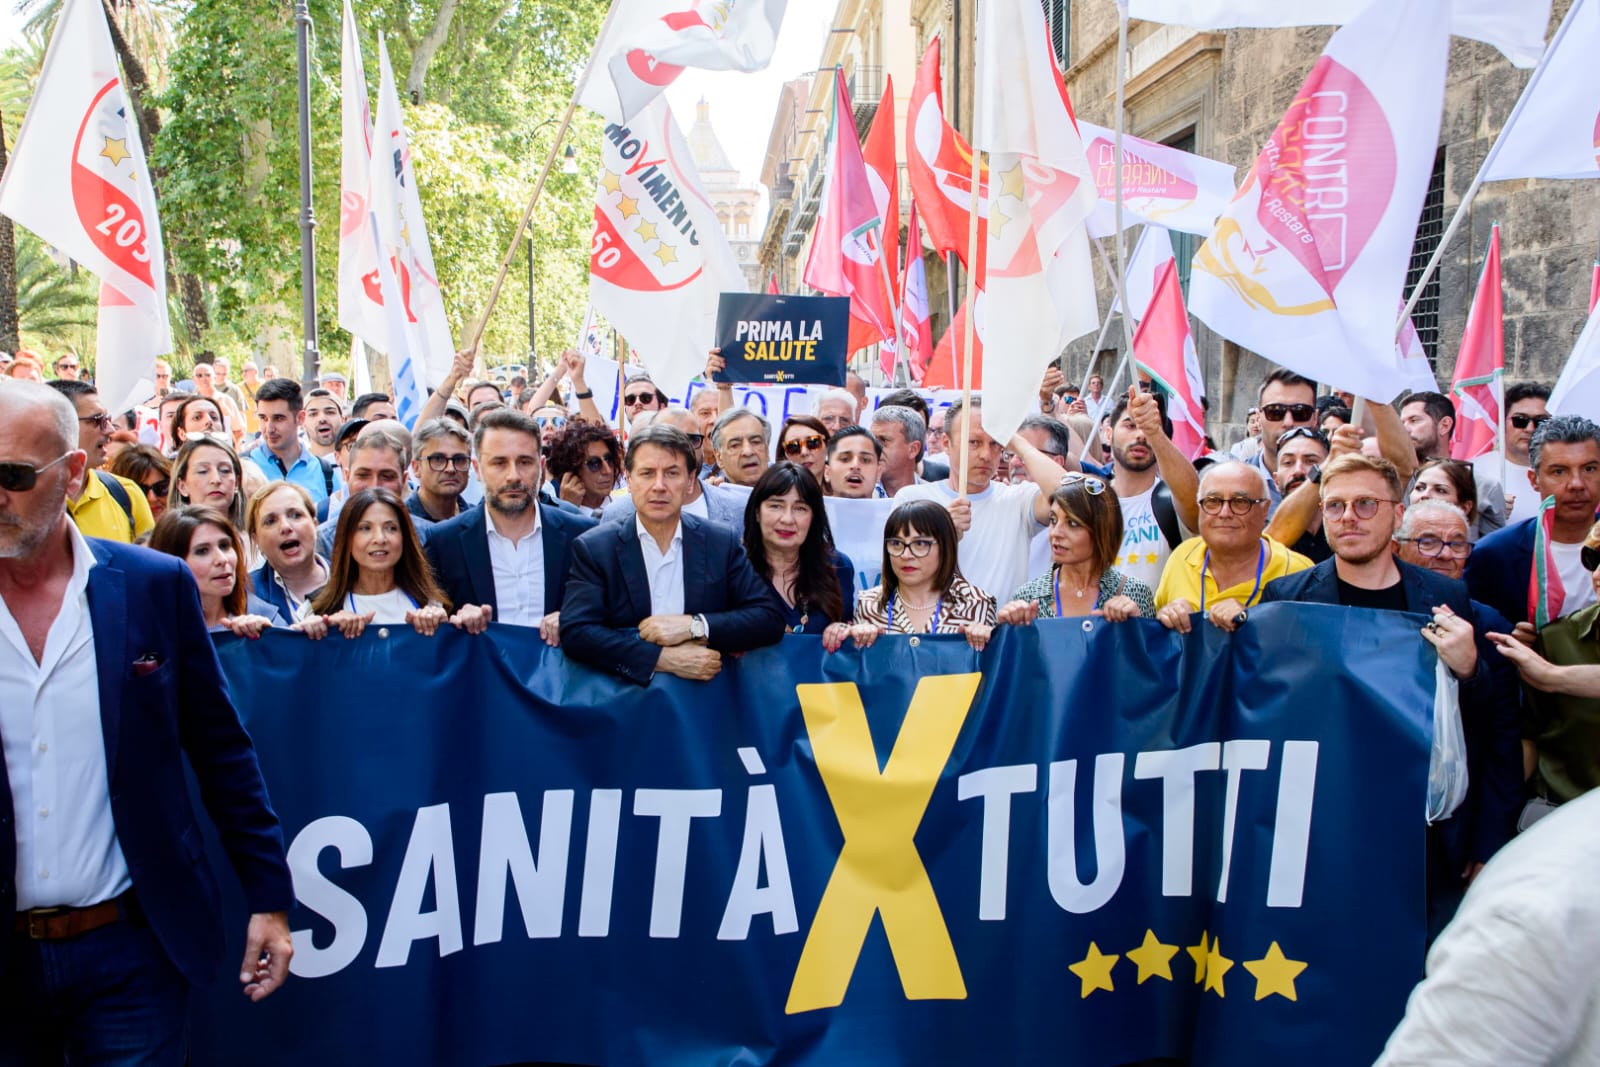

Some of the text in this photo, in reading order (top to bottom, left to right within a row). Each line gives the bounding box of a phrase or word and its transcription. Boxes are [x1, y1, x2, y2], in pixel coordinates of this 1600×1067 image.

[1265, 198, 1314, 244] Restare
[735, 319, 823, 341] PRIMA LA
[743, 340, 817, 361] SALUTE
[286, 671, 1319, 1015] SANITÀ X TUTTI
